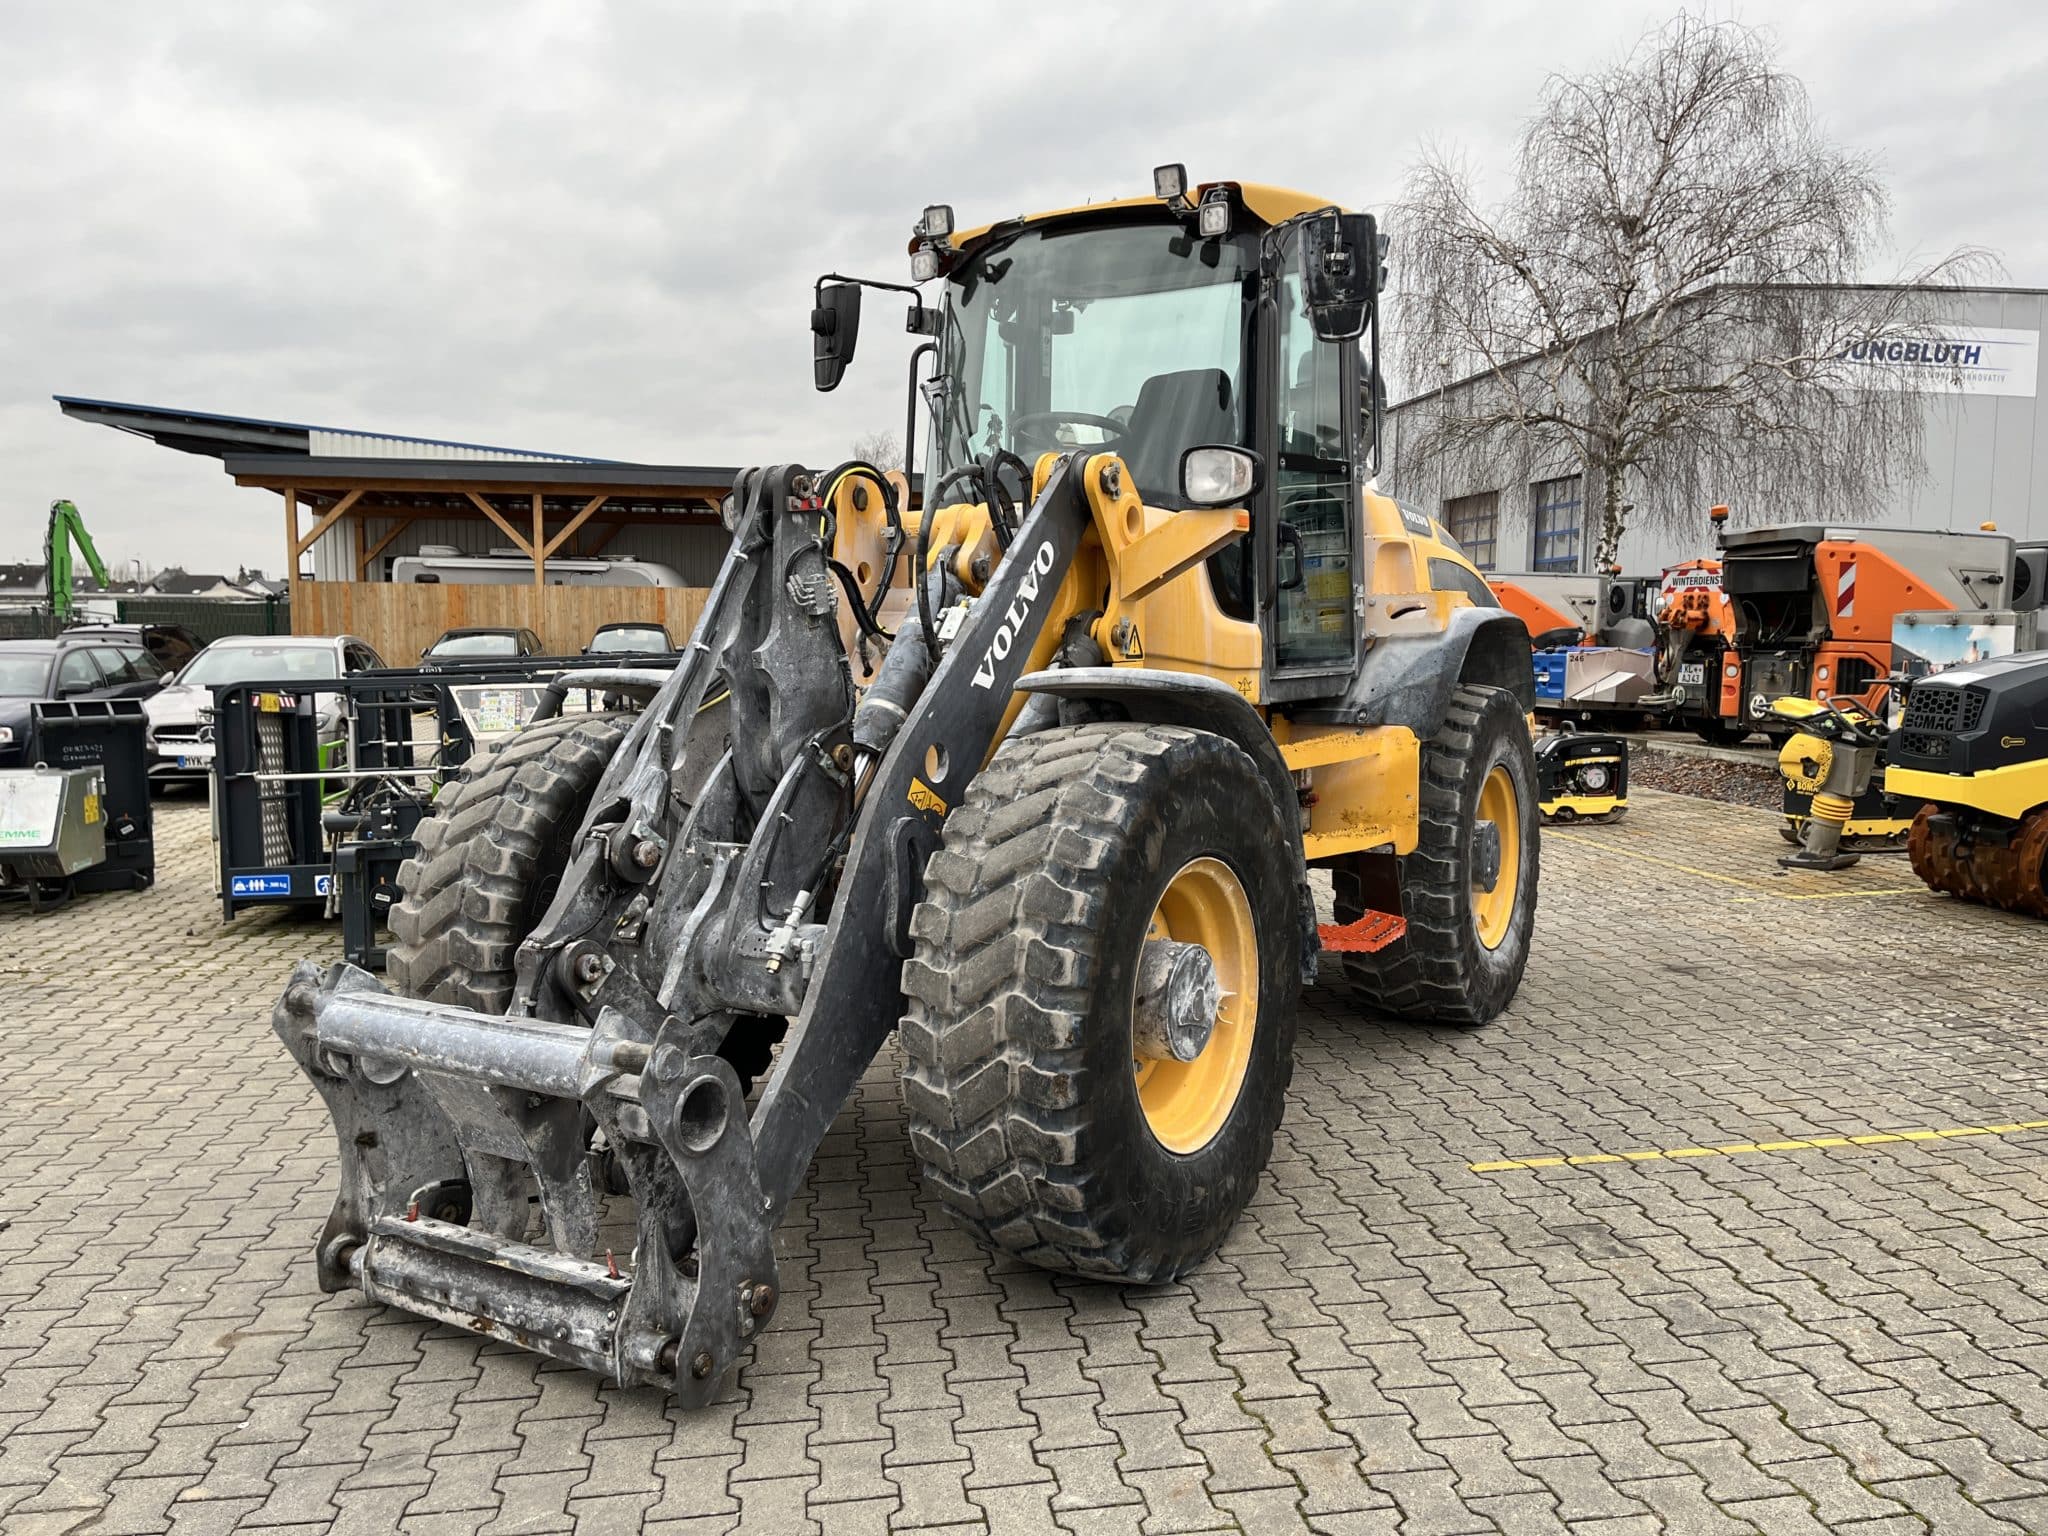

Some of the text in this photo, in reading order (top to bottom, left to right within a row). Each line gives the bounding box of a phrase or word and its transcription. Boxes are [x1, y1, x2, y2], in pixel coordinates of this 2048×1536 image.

[1836, 339, 1981, 365] JUNGBLUTH
[1401, 508, 1429, 528] VOLVO
[1672, 575, 1724, 586] WINTERDIENST
[970, 540, 1055, 690] VOLVO
[1904, 712, 1955, 732] BOMAG
[1796, 781, 1820, 792] BOMA
